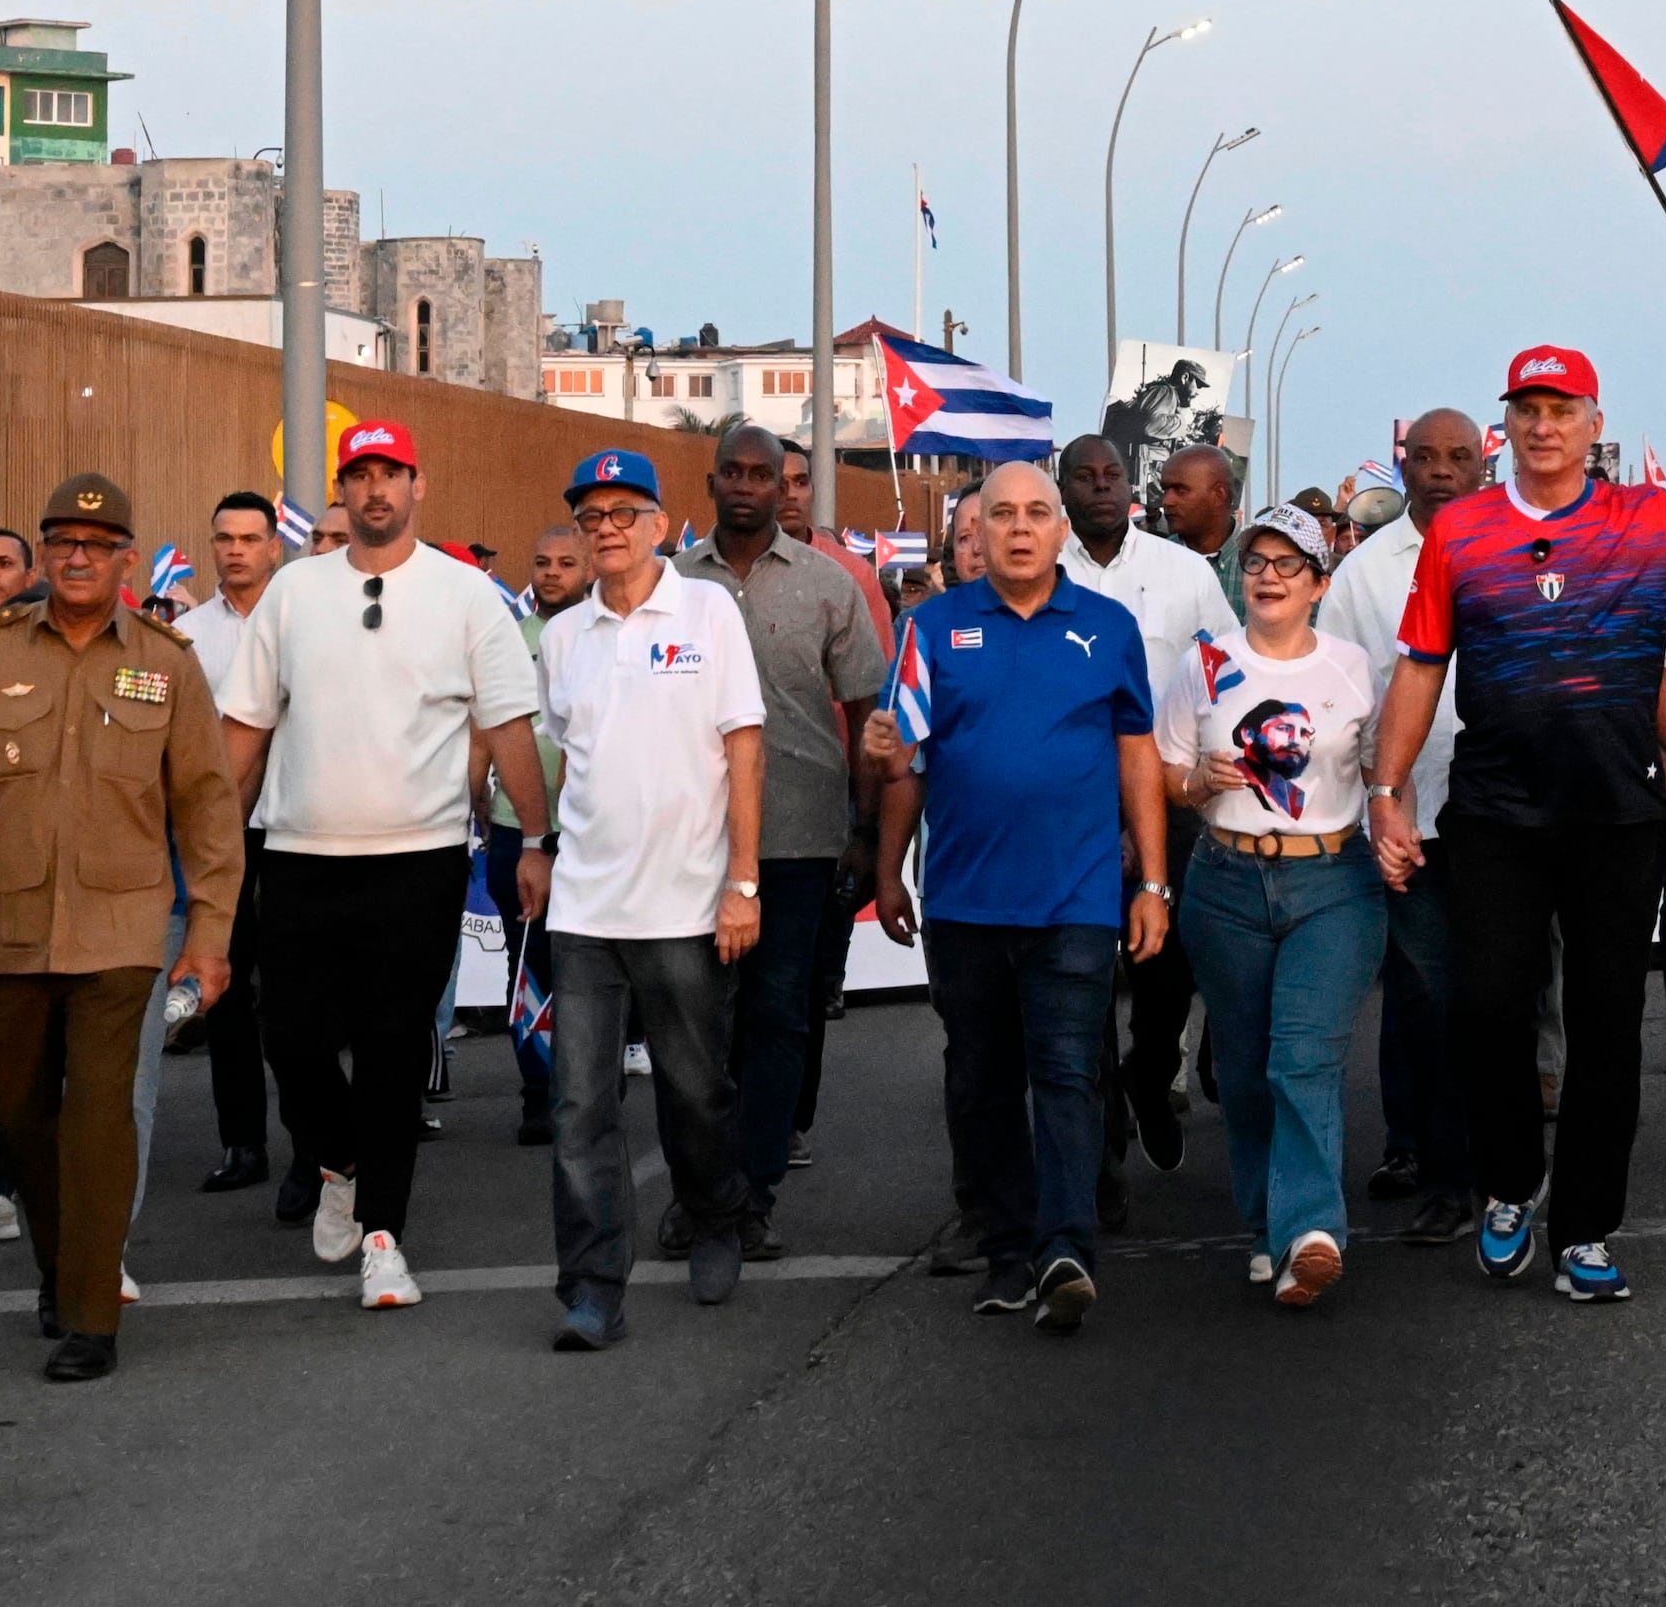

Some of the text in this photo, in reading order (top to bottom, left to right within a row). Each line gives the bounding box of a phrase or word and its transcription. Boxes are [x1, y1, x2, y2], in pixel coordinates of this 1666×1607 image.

[1519, 356, 1567, 381] Cuba
[350, 427, 395, 452] Cuba
[596, 455, 619, 481] C
[461, 916, 502, 934] ABAJ
